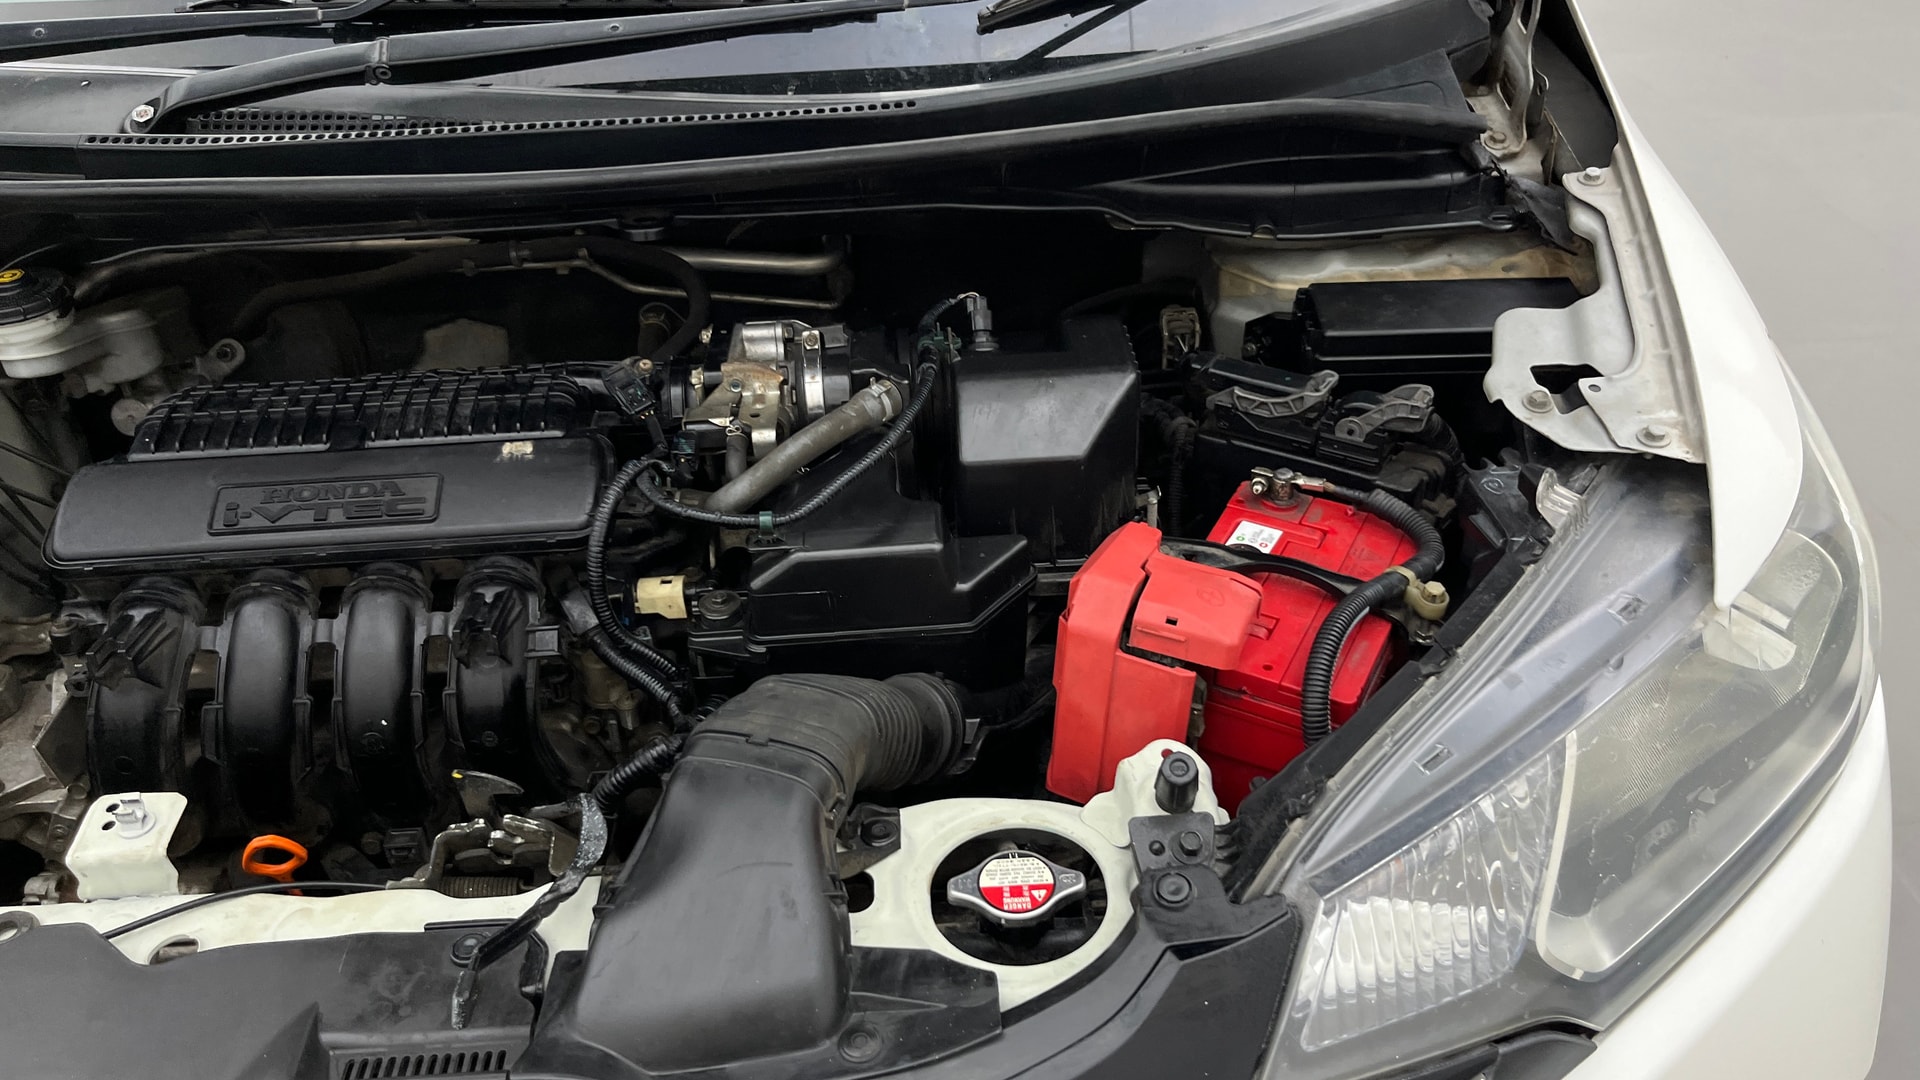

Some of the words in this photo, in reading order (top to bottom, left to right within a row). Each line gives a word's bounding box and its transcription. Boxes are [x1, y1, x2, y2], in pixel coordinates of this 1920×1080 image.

[260, 481, 405, 504] HONDA
[223, 497, 426, 527] i-VTEC
[1003, 902, 1032, 910] DANGER
